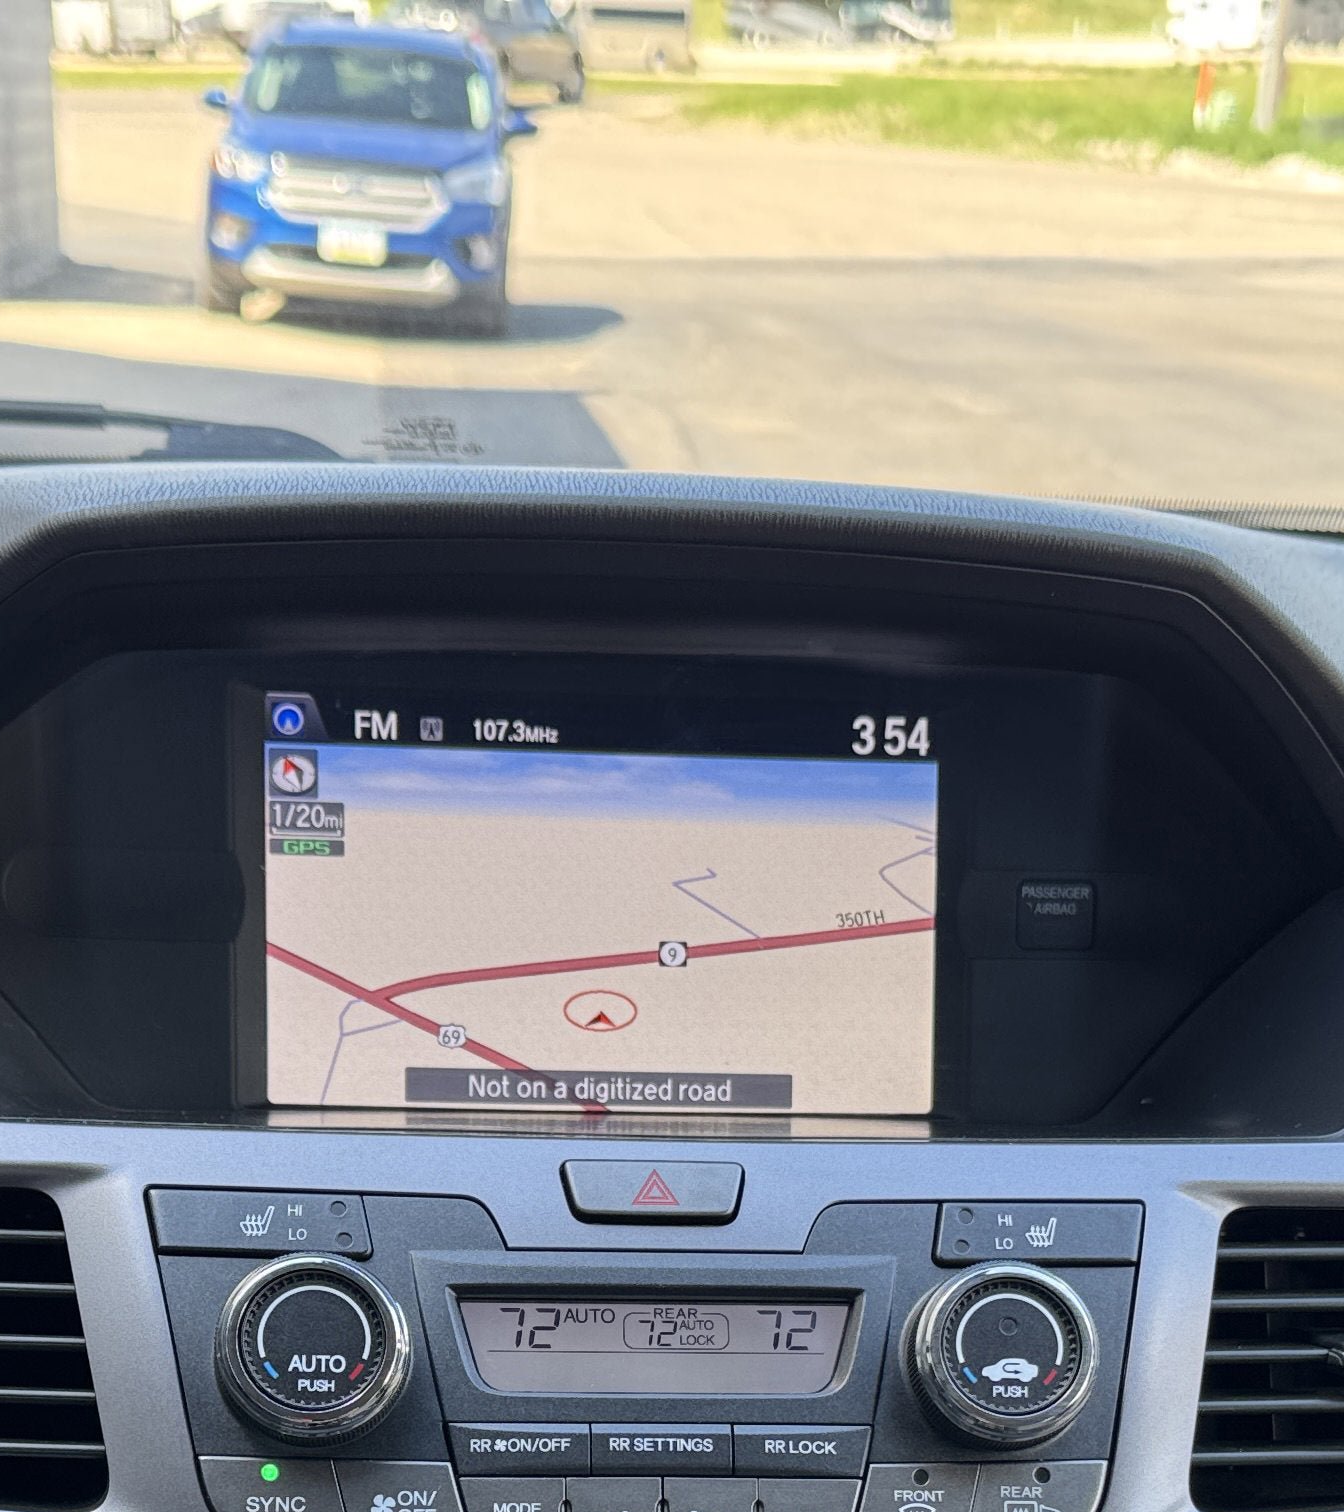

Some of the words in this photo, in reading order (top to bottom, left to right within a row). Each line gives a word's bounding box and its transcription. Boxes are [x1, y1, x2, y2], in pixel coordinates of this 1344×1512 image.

[354, 709, 398, 740] FM
[282, 839, 331, 856] GPS
[1021, 886, 1090, 900] PASSENGER
[835, 909, 885, 929] 350TH
[668, 947, 678, 962] 9
[441, 1029, 461, 1045] 69
[468, 1074, 510, 1099] Not
[517, 1079, 546, 1099] on
[554, 1080, 568, 1100] a
[574, 1076, 672, 1104] digitized
[678, 1078, 732, 1102] road
[287, 1204, 303, 1217] HI
[997, 1214, 1013, 1227] HI
[288, 1228, 307, 1241] LO
[995, 1237, 1013, 1250] LO
[653, 1307, 698, 1321] REAR
[499, 1307, 560, 1350] 72
[563, 1308, 616, 1324] AUTO
[638, 1320, 677, 1347] 72
[678, 1319, 715, 1331] AUTO
[757, 1309, 817, 1351] 72
[678, 1333, 716, 1346] LOCK
[287, 1354, 346, 1373] AUTO
[297, 1379, 335, 1393] PUSH
[992, 1386, 1029, 1398] PUSH
[469, 1438, 492, 1453] RR
[507, 1438, 571, 1453] ON/OFF
[609, 1437, 630, 1452] RR
[633, 1437, 714, 1453] SETTINGS
[764, 1439, 786, 1454] RR
[788, 1440, 837, 1455] LOCK
[397, 1490, 438, 1507] ON/
[893, 1490, 945, 1502] FRONT
[1000, 1485, 1043, 1499] REAR
[245, 1496, 307, 1512] SYNC
